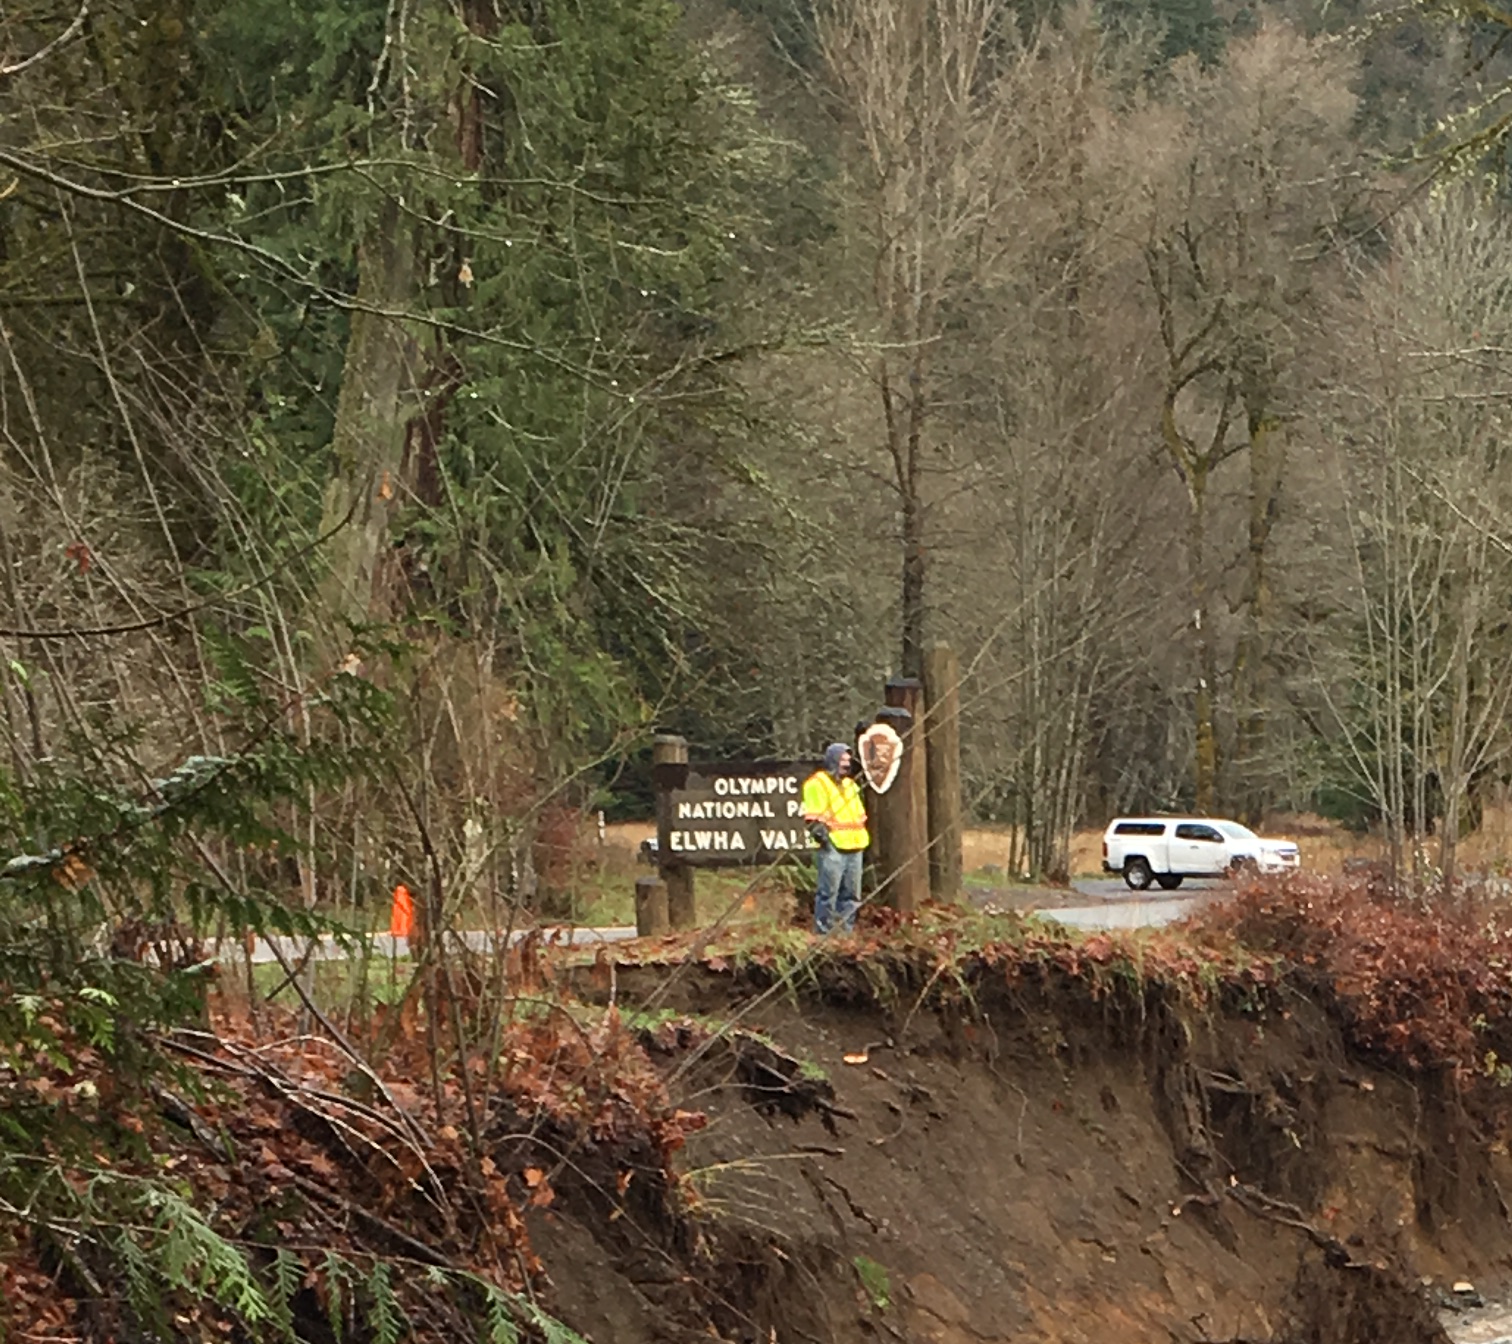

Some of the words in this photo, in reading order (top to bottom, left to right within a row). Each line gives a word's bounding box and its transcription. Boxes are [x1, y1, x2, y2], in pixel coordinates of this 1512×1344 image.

[714, 776, 798, 796] OLYMPIC
[678, 800, 775, 819] NATIONAL
[786, 800, 807, 818] PA
[669, 830, 746, 851] ELWHA
[759, 829, 820, 850] VALL
